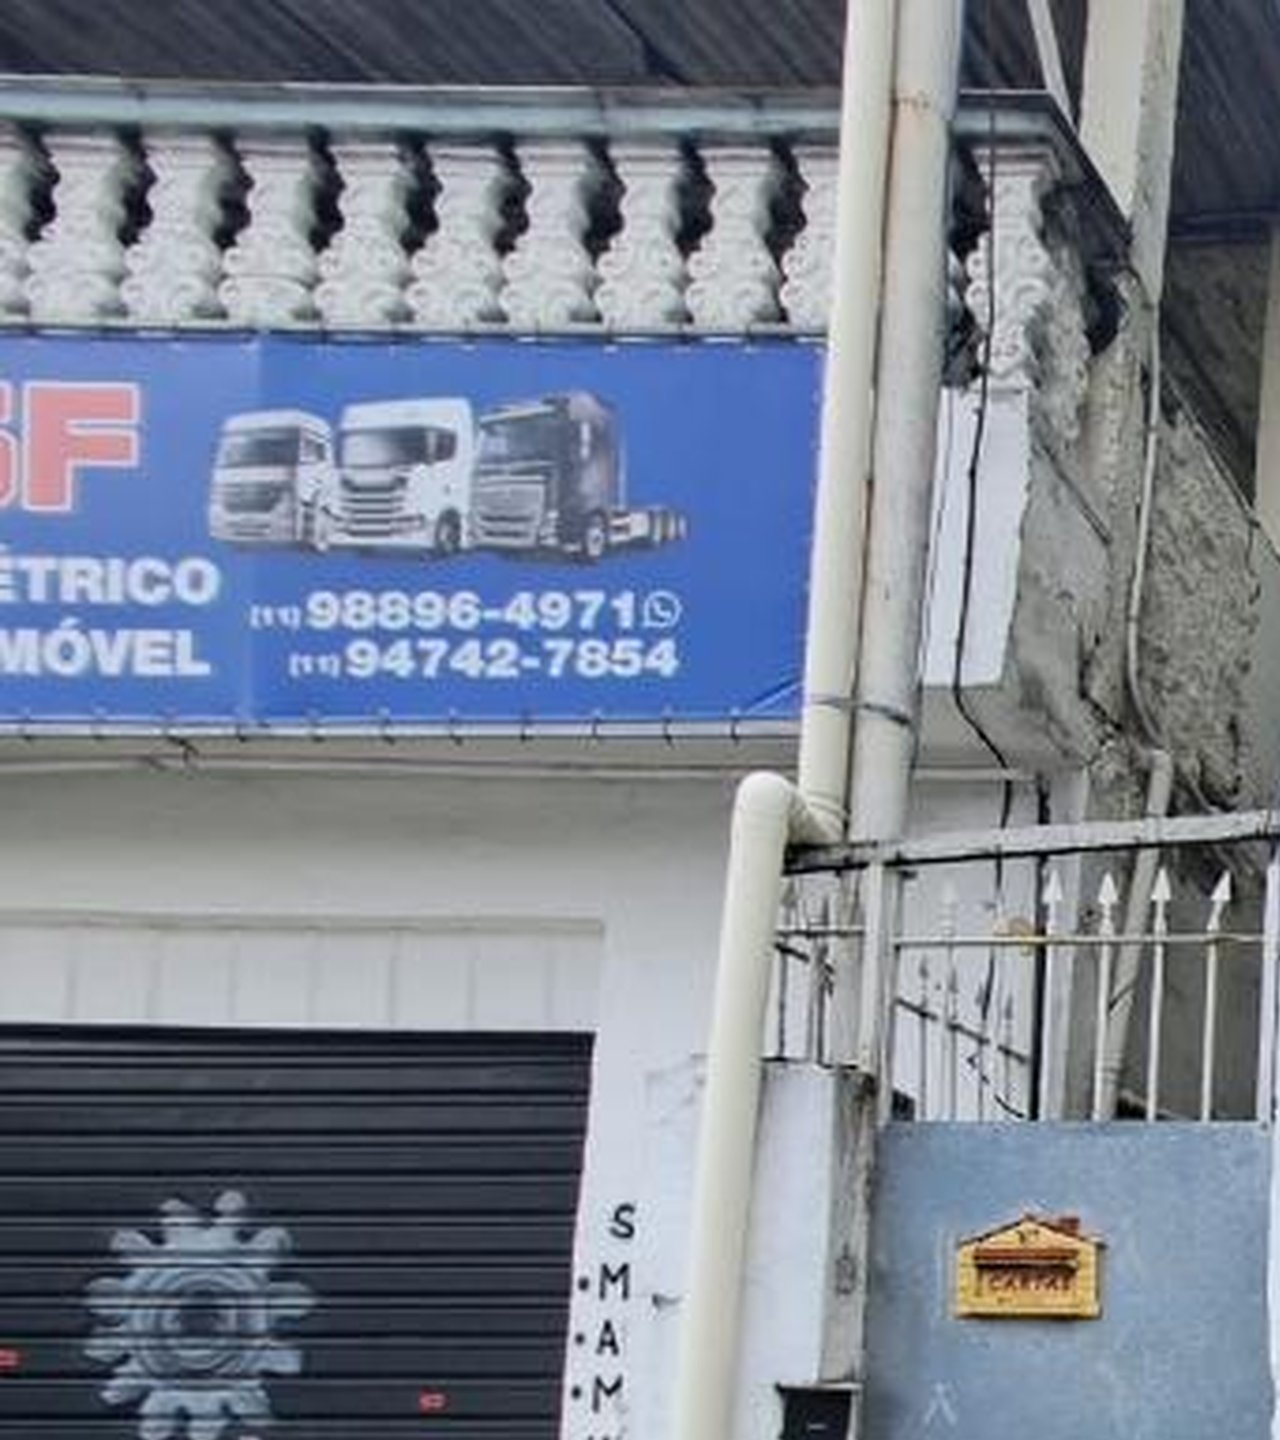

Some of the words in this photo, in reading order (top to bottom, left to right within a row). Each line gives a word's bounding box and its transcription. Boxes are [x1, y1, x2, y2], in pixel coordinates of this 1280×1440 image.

[0, 382, 140, 511] F
[306, 591, 637, 630] 98896-4971
[345, 639, 679, 679] 94742-7854
